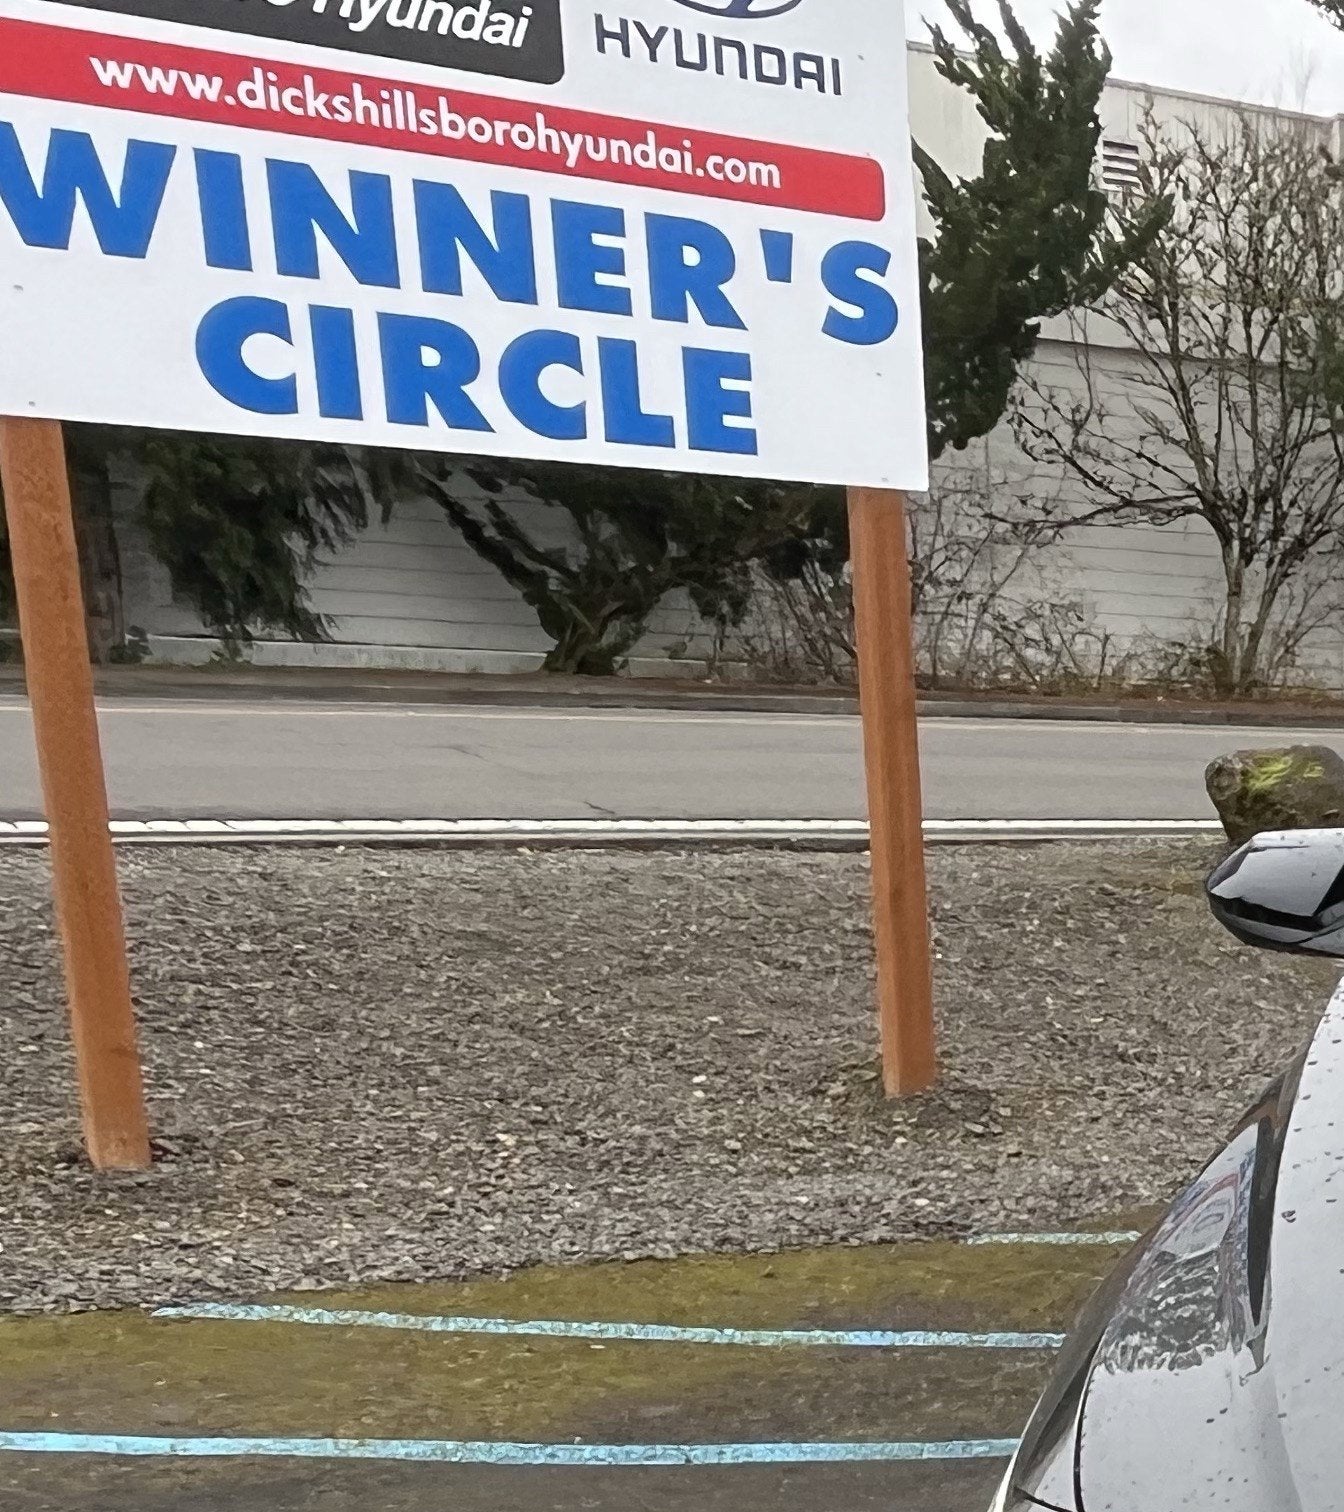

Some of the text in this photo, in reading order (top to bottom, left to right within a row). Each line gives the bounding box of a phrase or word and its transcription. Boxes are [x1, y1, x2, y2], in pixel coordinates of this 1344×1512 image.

[88, 56, 782, 189] www.dickshillsborohyundai.com
[595, 13, 842, 96] HYUNDAI
[0, 121, 900, 346] WINNER'S
[195, 296, 758, 456] CIRCLE
